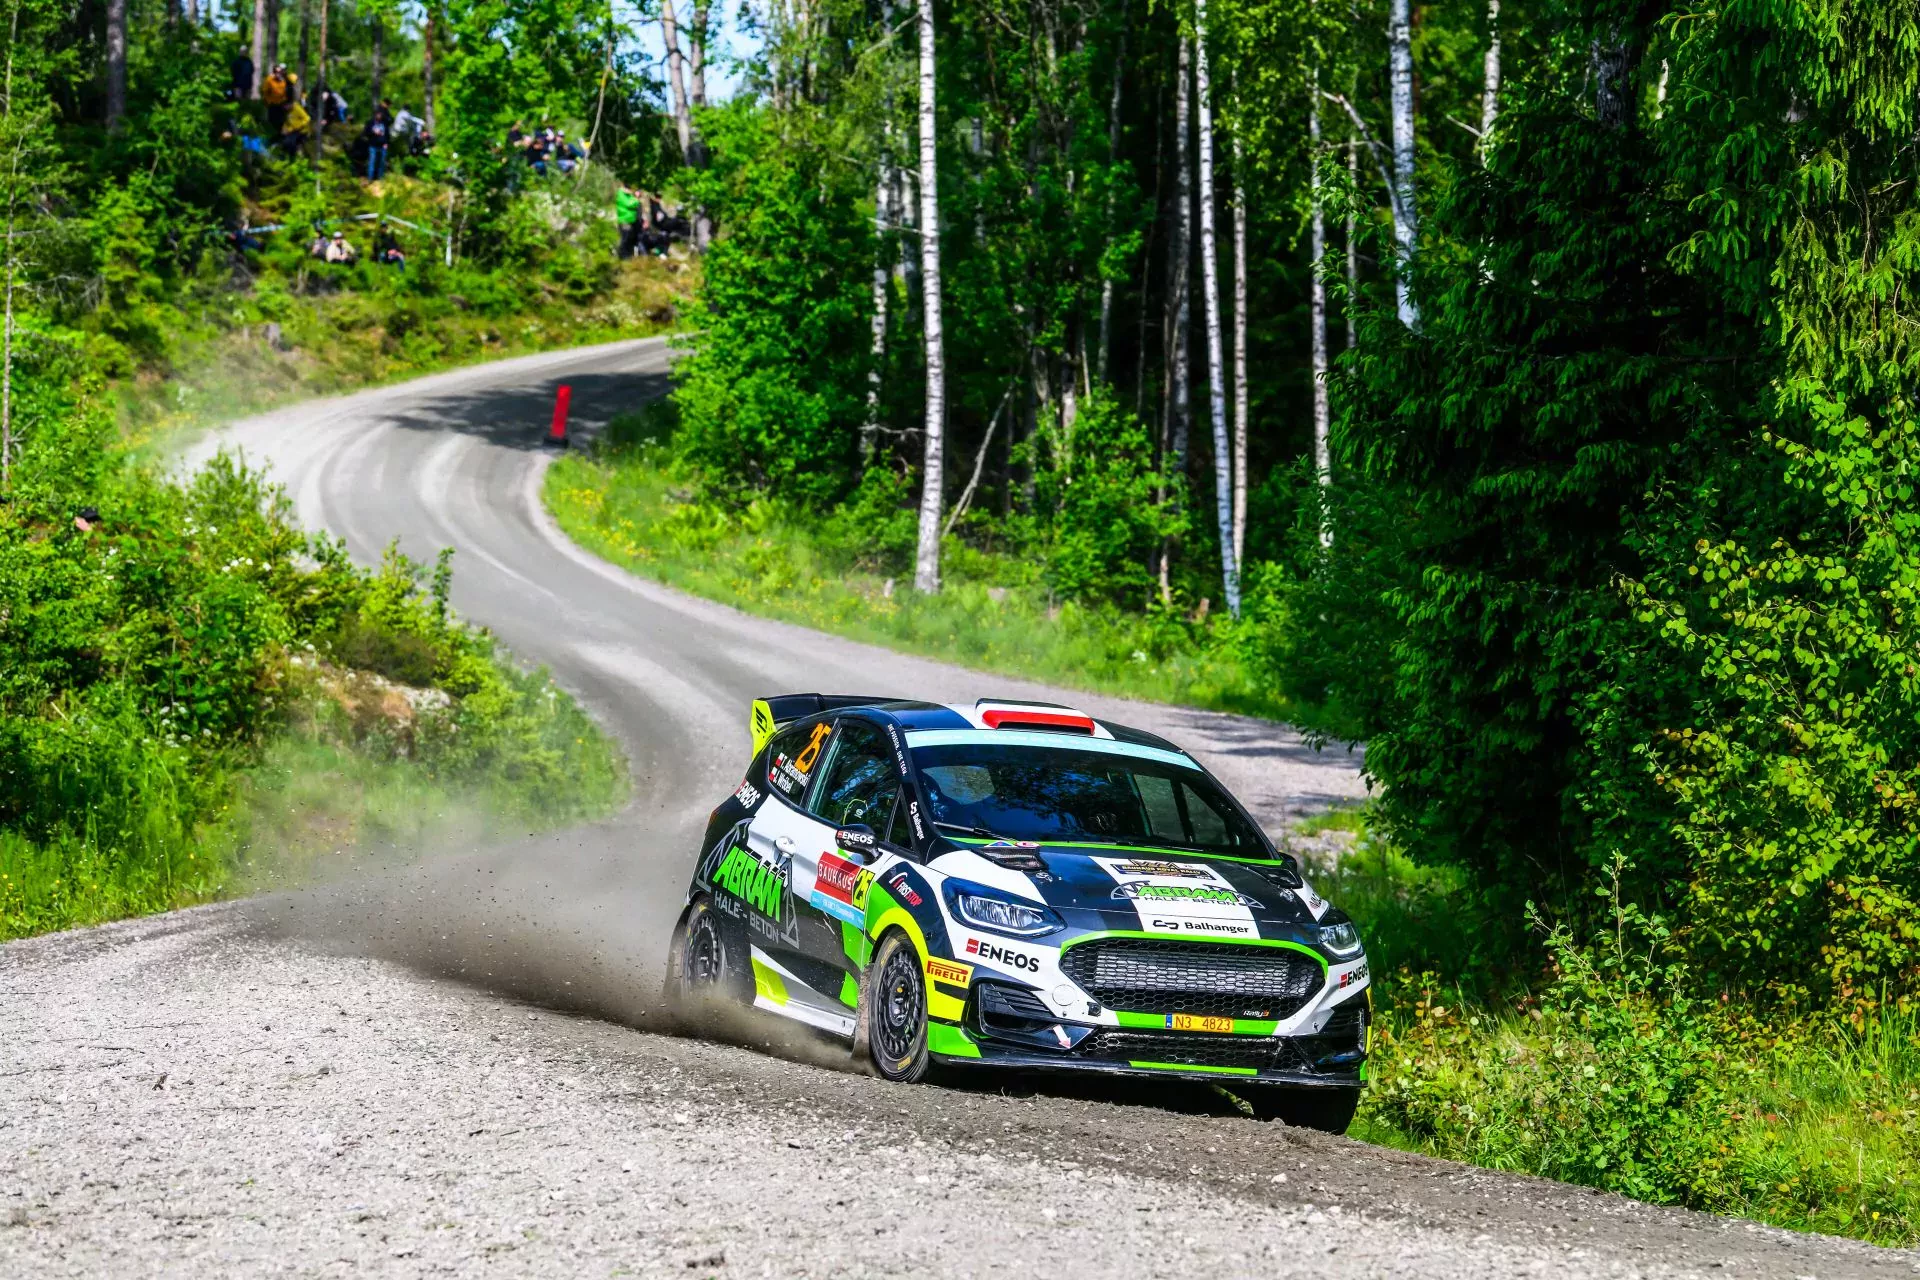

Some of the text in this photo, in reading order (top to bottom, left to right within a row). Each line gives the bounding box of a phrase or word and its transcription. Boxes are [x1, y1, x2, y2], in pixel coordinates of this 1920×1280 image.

[795, 723, 831, 773] 25
[737, 781, 760, 808] ENEOS
[842, 832, 873, 844] ENEOS
[713, 846, 783, 923] ABRAM
[819, 864, 853, 890] BAUHAUS
[853, 868, 876, 910] 25
[1136, 885, 1239, 902] ABRAM
[715, 891, 742, 918] HALE
[750, 911, 779, 943] BETON
[1185, 921, 1249, 934] Balhanger
[978, 941, 1040, 973] ENEOS
[927, 960, 968, 983] PIRELLI
[1175, 1015, 1231, 1031] N3 4823
